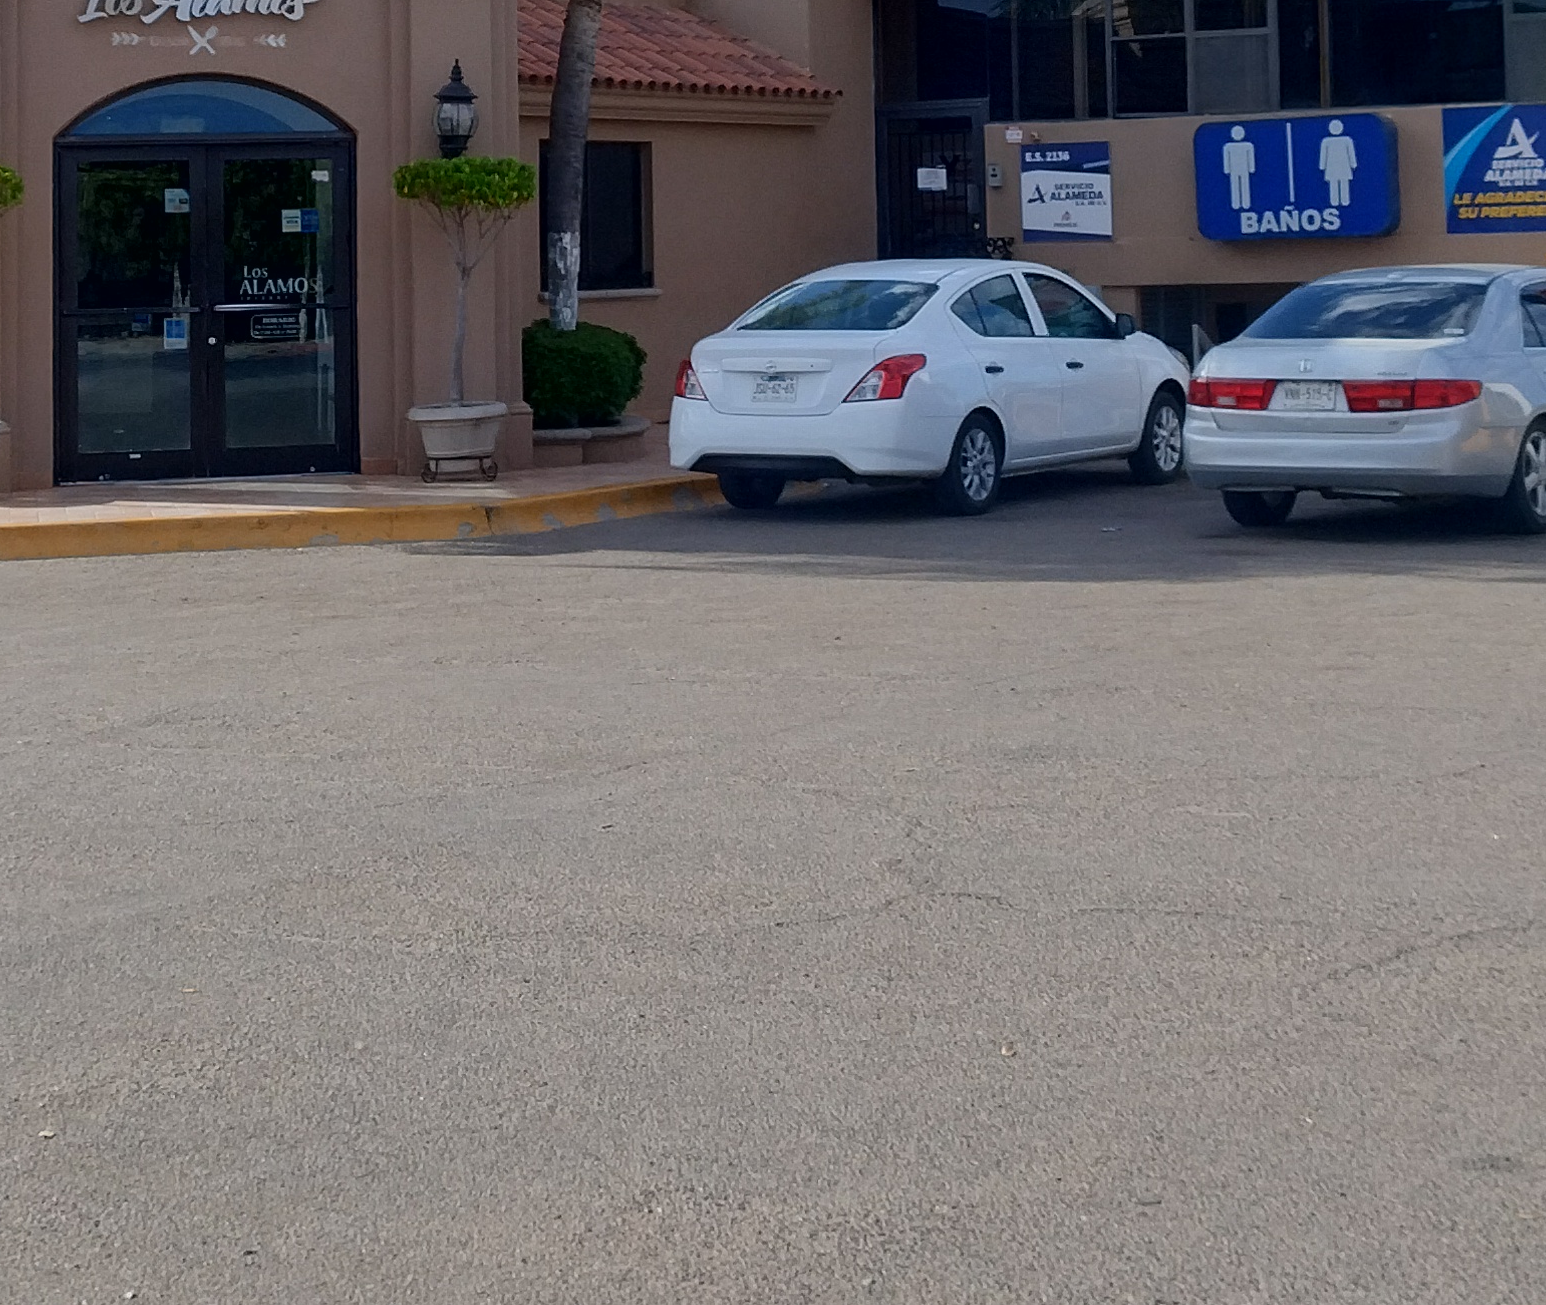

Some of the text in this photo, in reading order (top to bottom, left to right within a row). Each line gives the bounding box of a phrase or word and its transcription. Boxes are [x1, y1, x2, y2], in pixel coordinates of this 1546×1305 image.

[1054, 183, 1094, 191] SERVICIO
[1049, 191, 1104, 202] ALAMEDA
[1454, 192, 1473, 205] LE
[1458, 206, 1479, 219] SU
[1240, 205, 1341, 234] BAÑOS
[239, 277, 318, 295] ALAMOS
